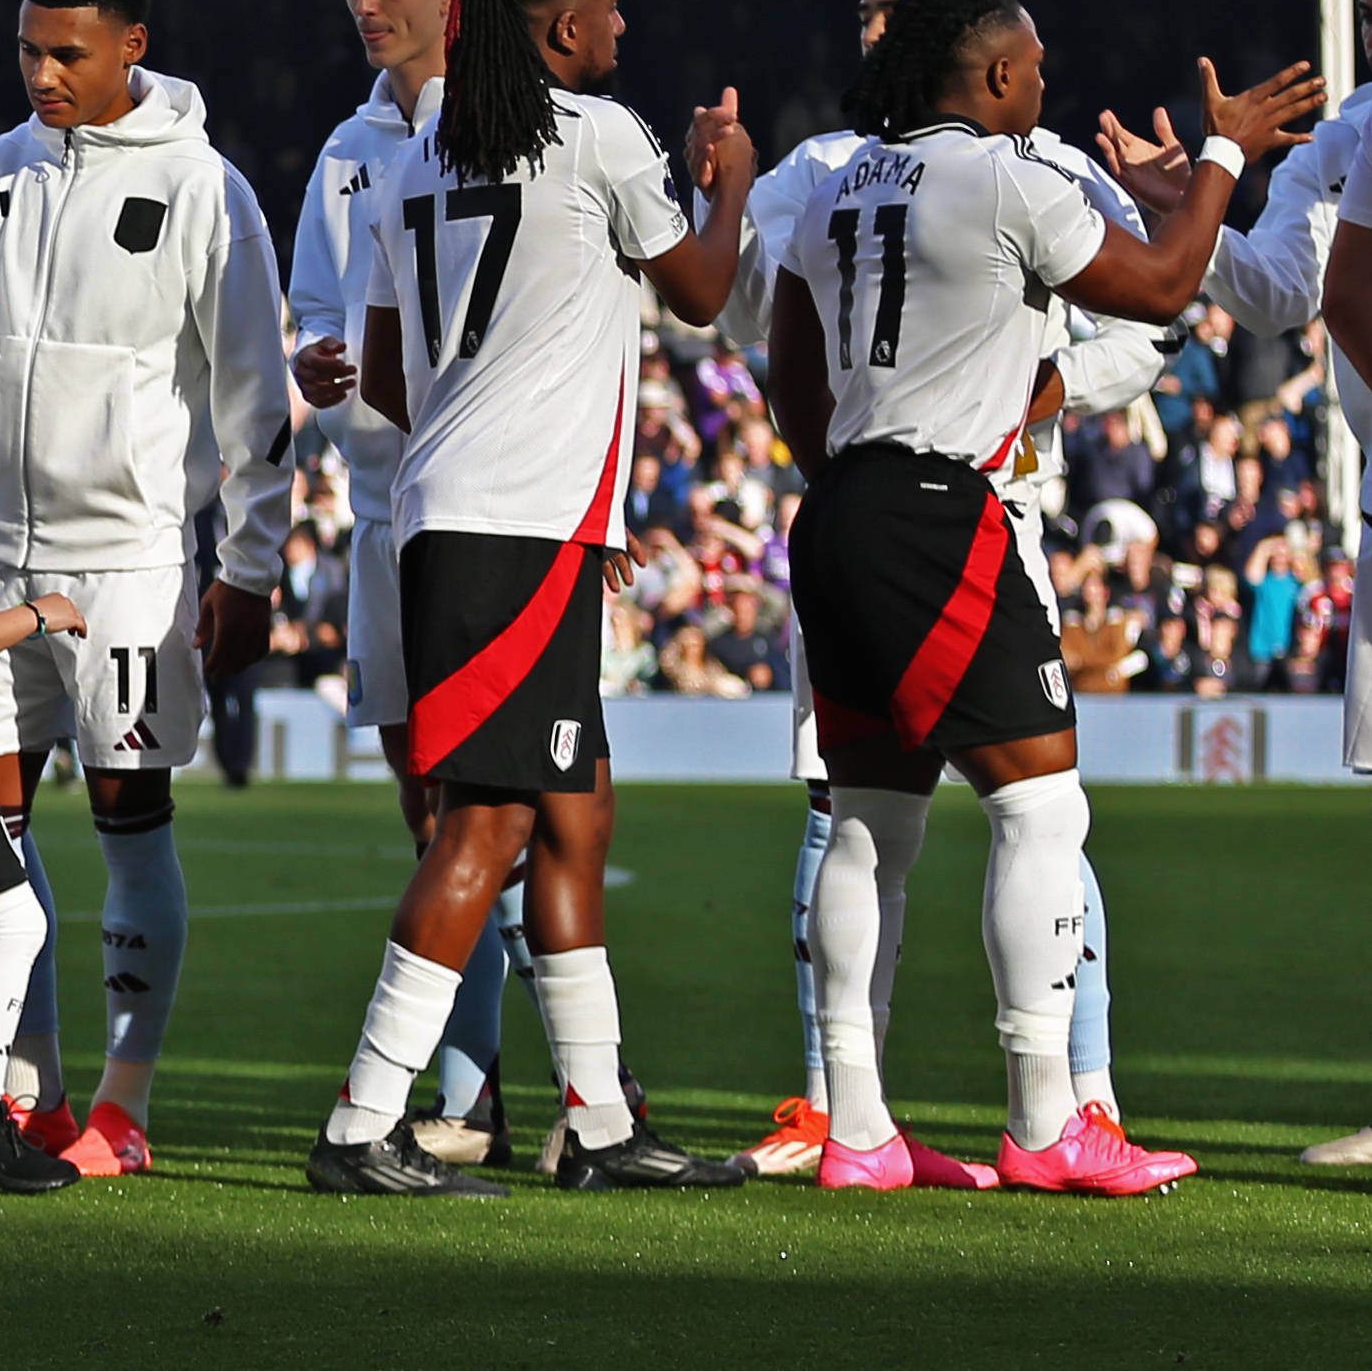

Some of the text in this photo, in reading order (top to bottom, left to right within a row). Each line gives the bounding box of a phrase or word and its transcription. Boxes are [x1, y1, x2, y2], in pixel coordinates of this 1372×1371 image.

[835, 153, 926, 204] ADAMA
[402, 182, 522, 369] 17
[827, 203, 909, 371] 11
[110, 647, 158, 714] 11
[1055, 916, 1082, 937] FF
